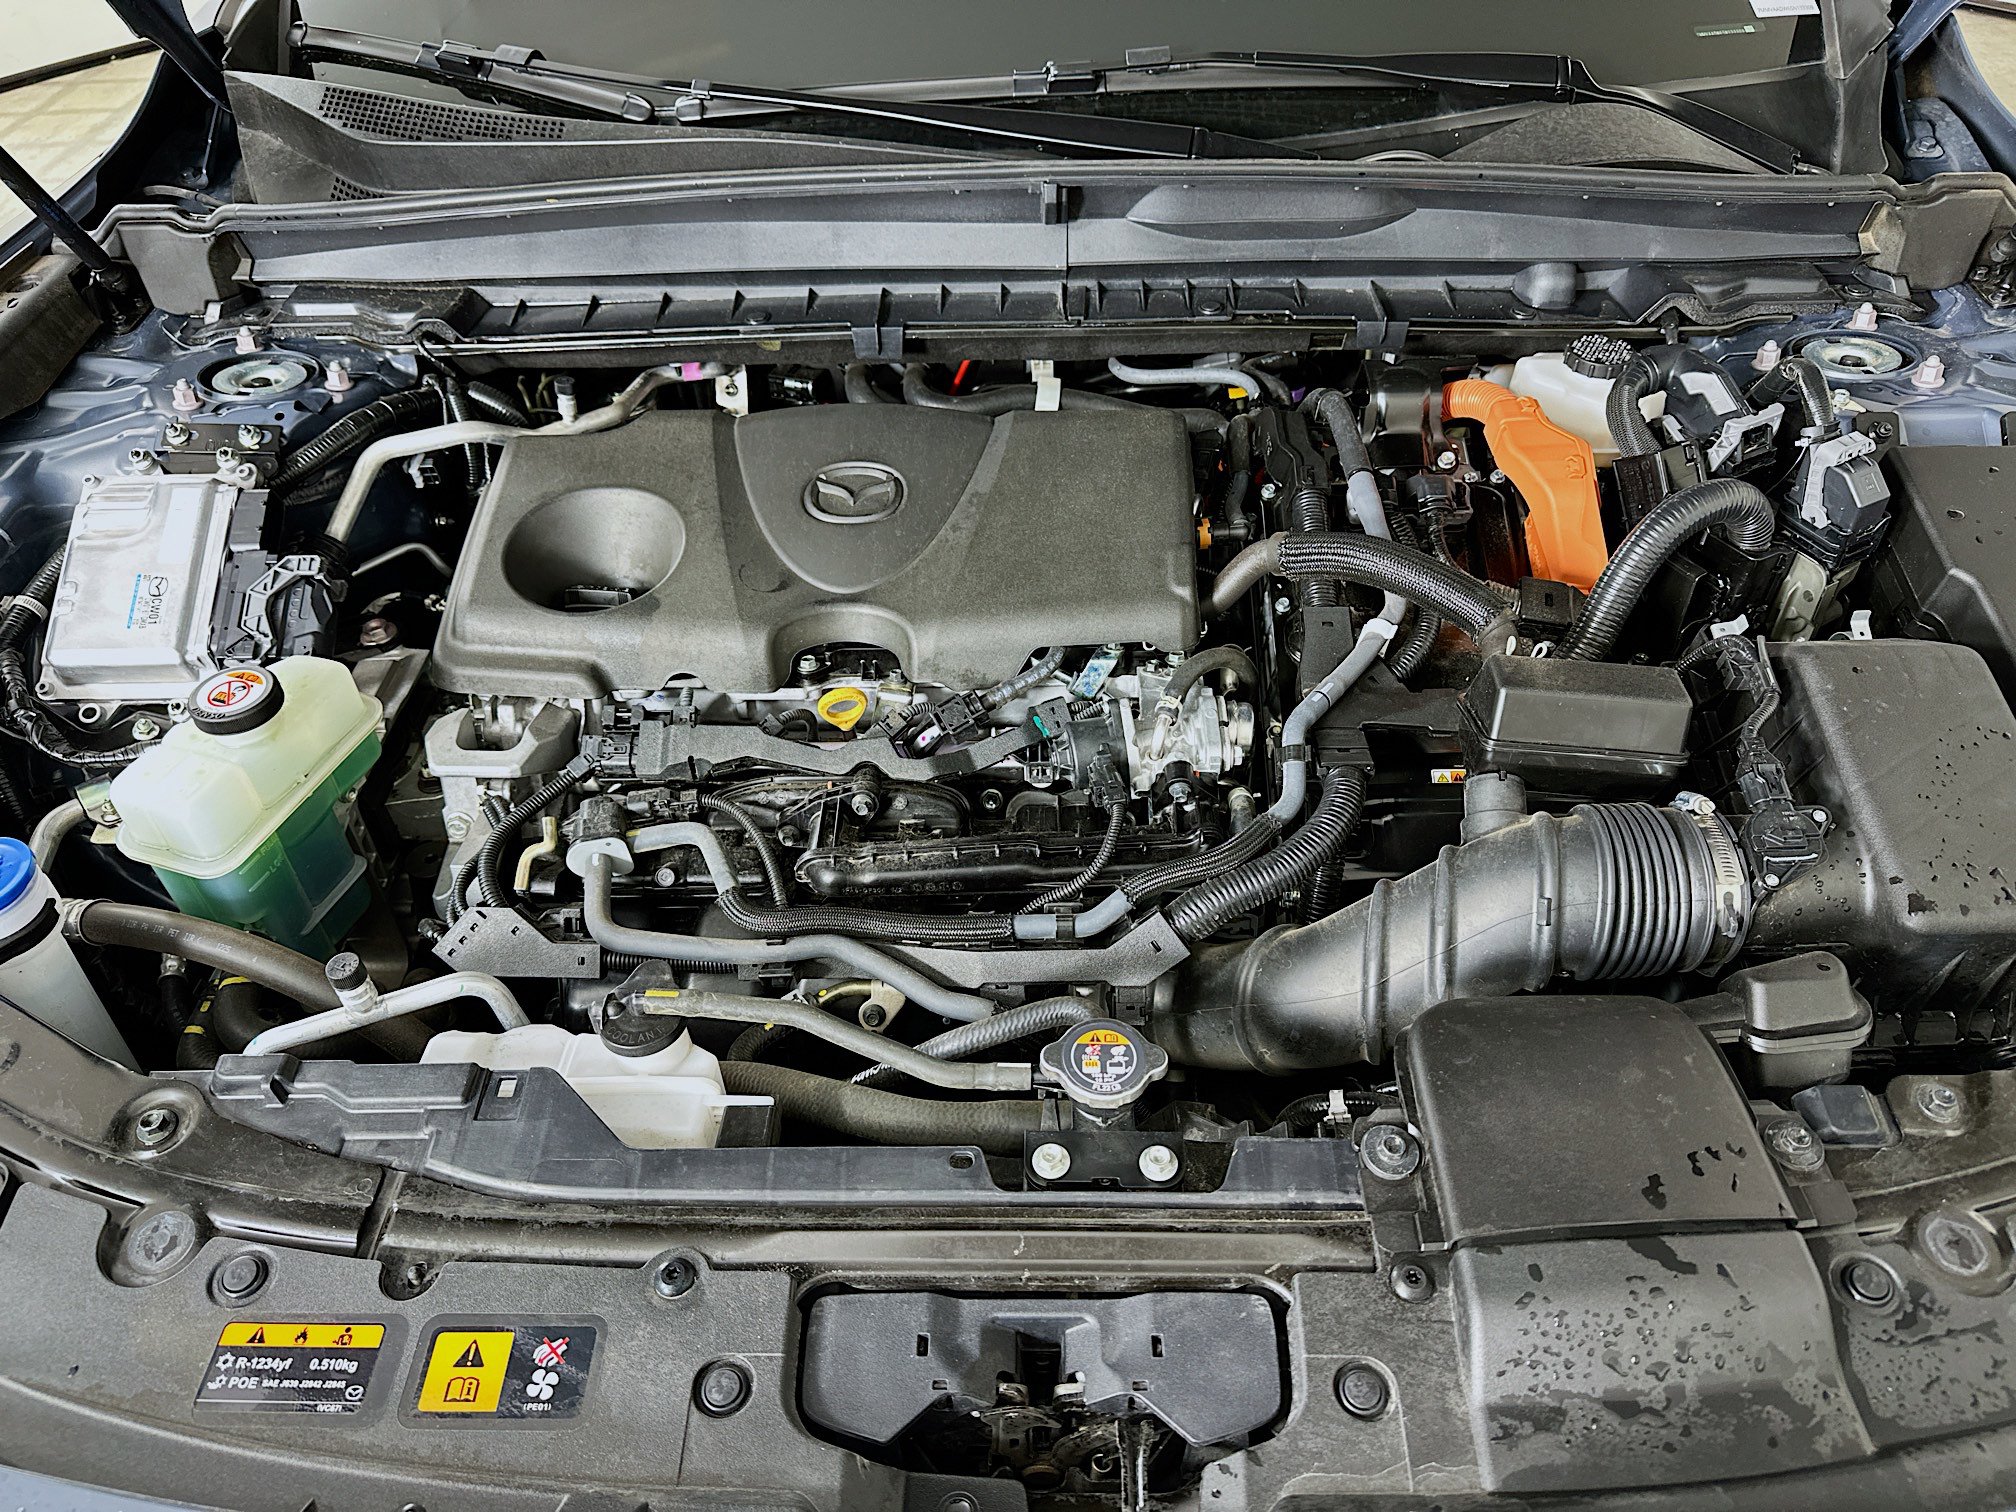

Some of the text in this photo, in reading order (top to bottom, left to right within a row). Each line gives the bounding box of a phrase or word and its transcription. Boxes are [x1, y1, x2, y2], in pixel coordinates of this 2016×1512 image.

[148, 598, 162, 625] CW01
[192, 707, 226, 719] DENSO
[167, 928, 180, 938] PET
[606, 1026, 663, 1044] COOLANT
[1091, 1083, 1111, 1092] FL22
[235, 1357, 359, 1374] R-1234yf 0.510kg
[227, 1377, 259, 1389] POE
[262, 1378, 281, 1388] SAE
[523, 1402, 552, 1411] (PE01)
